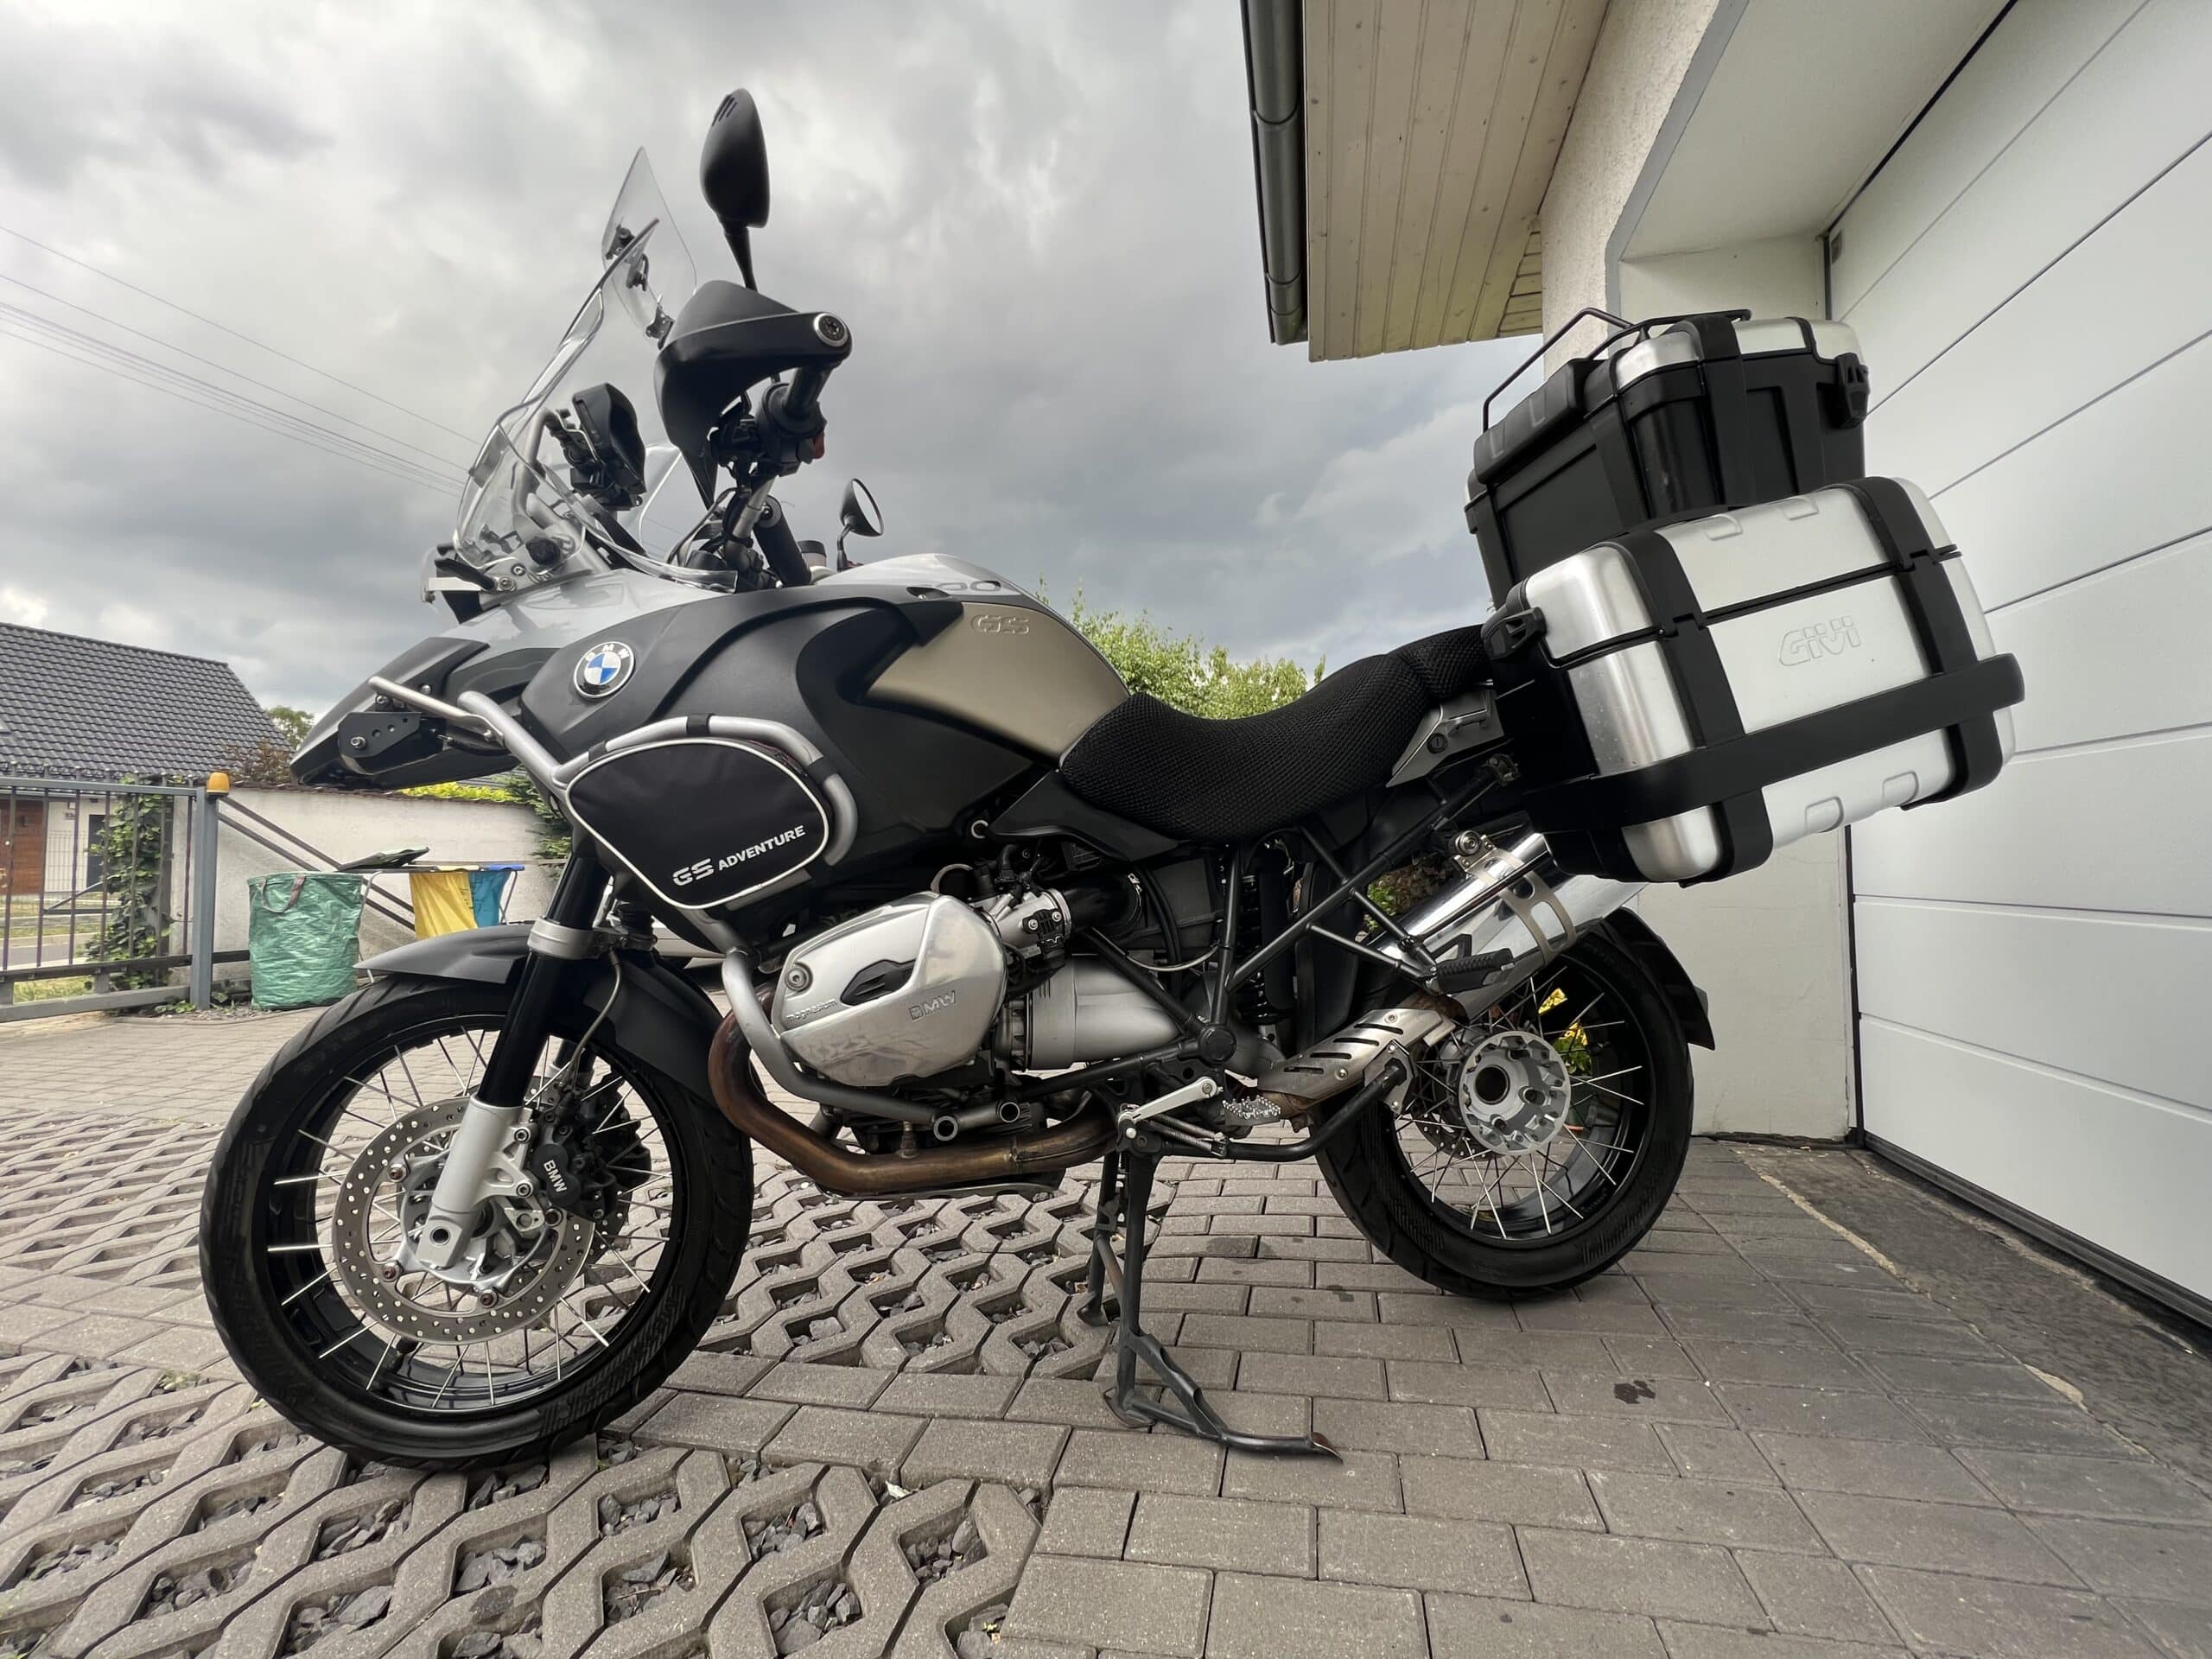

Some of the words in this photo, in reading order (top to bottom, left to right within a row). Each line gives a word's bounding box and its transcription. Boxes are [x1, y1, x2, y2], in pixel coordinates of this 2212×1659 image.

[672, 858, 715, 887] GS
[718, 824, 806, 872] ADVENTURE
[908, 989, 957, 1021] BMW
[543, 1159, 568, 1193] BMW
